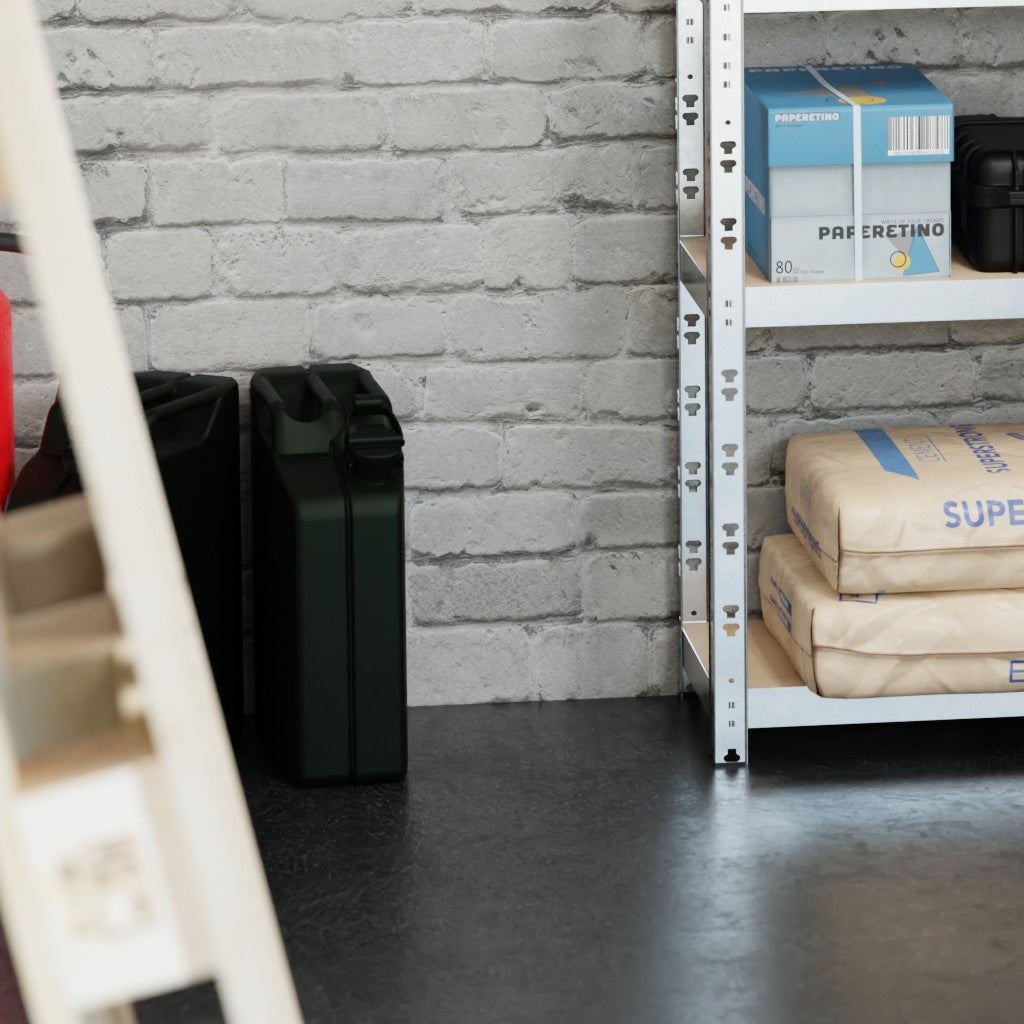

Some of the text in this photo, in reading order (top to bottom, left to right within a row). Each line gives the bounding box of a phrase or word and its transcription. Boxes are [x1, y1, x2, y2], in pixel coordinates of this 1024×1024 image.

[774, 112, 840, 123] PAPERETINO
[818, 223, 945, 240] PAPERETINO
[776, 260, 793, 274] 80
